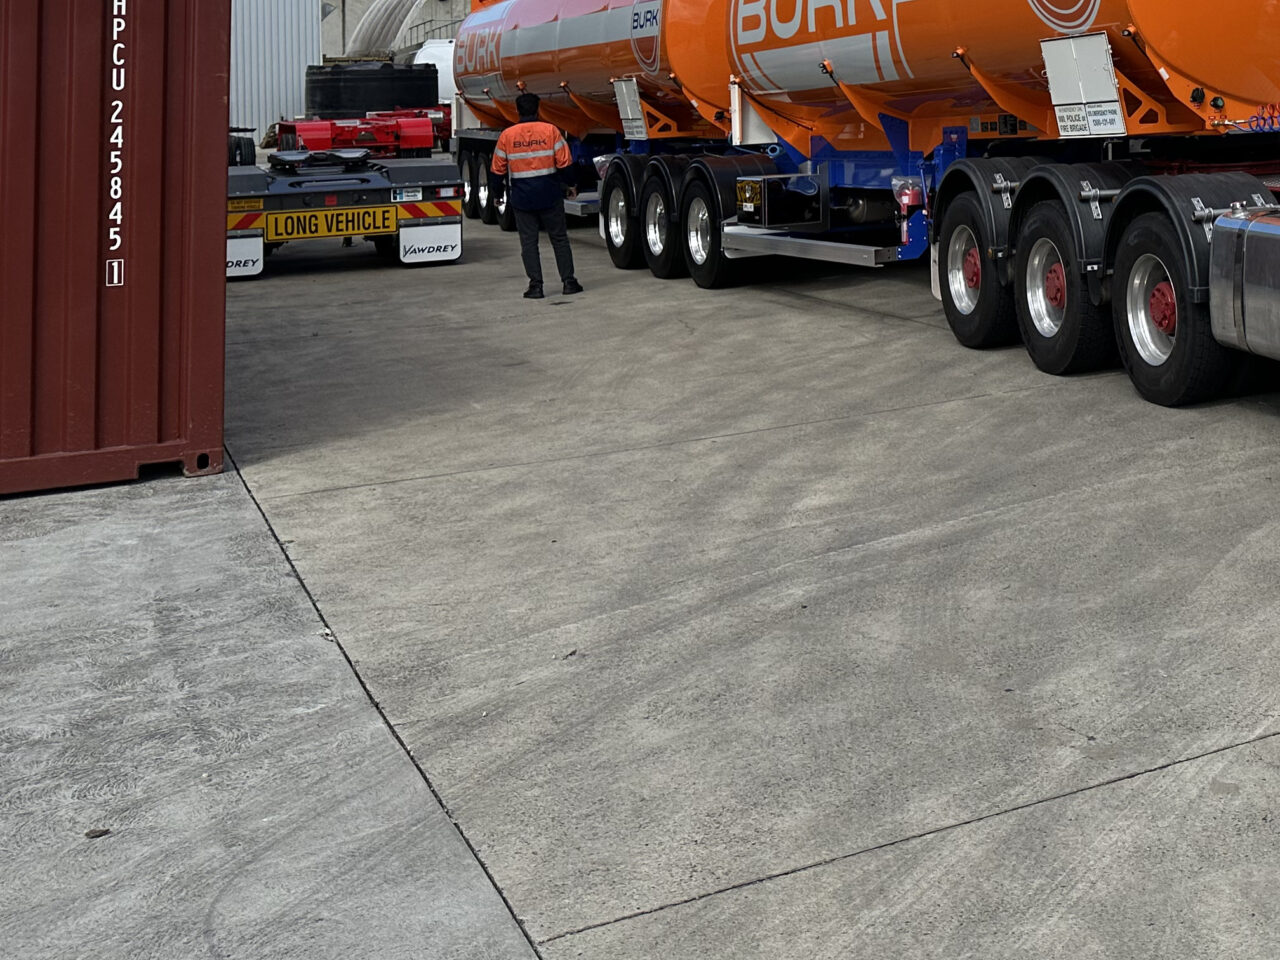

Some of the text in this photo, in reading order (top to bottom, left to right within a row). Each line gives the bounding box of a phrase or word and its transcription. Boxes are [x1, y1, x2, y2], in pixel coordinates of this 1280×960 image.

[632, 8, 659, 30] BURK
[456, 25, 502, 74] BURK
[513, 139, 547, 148] BURK
[109, 100, 124, 251] 245845
[274, 210, 391, 237] LONG VEHICLE
[403, 243, 458, 258] VAWDREY
[109, 261, 121, 285] 1
